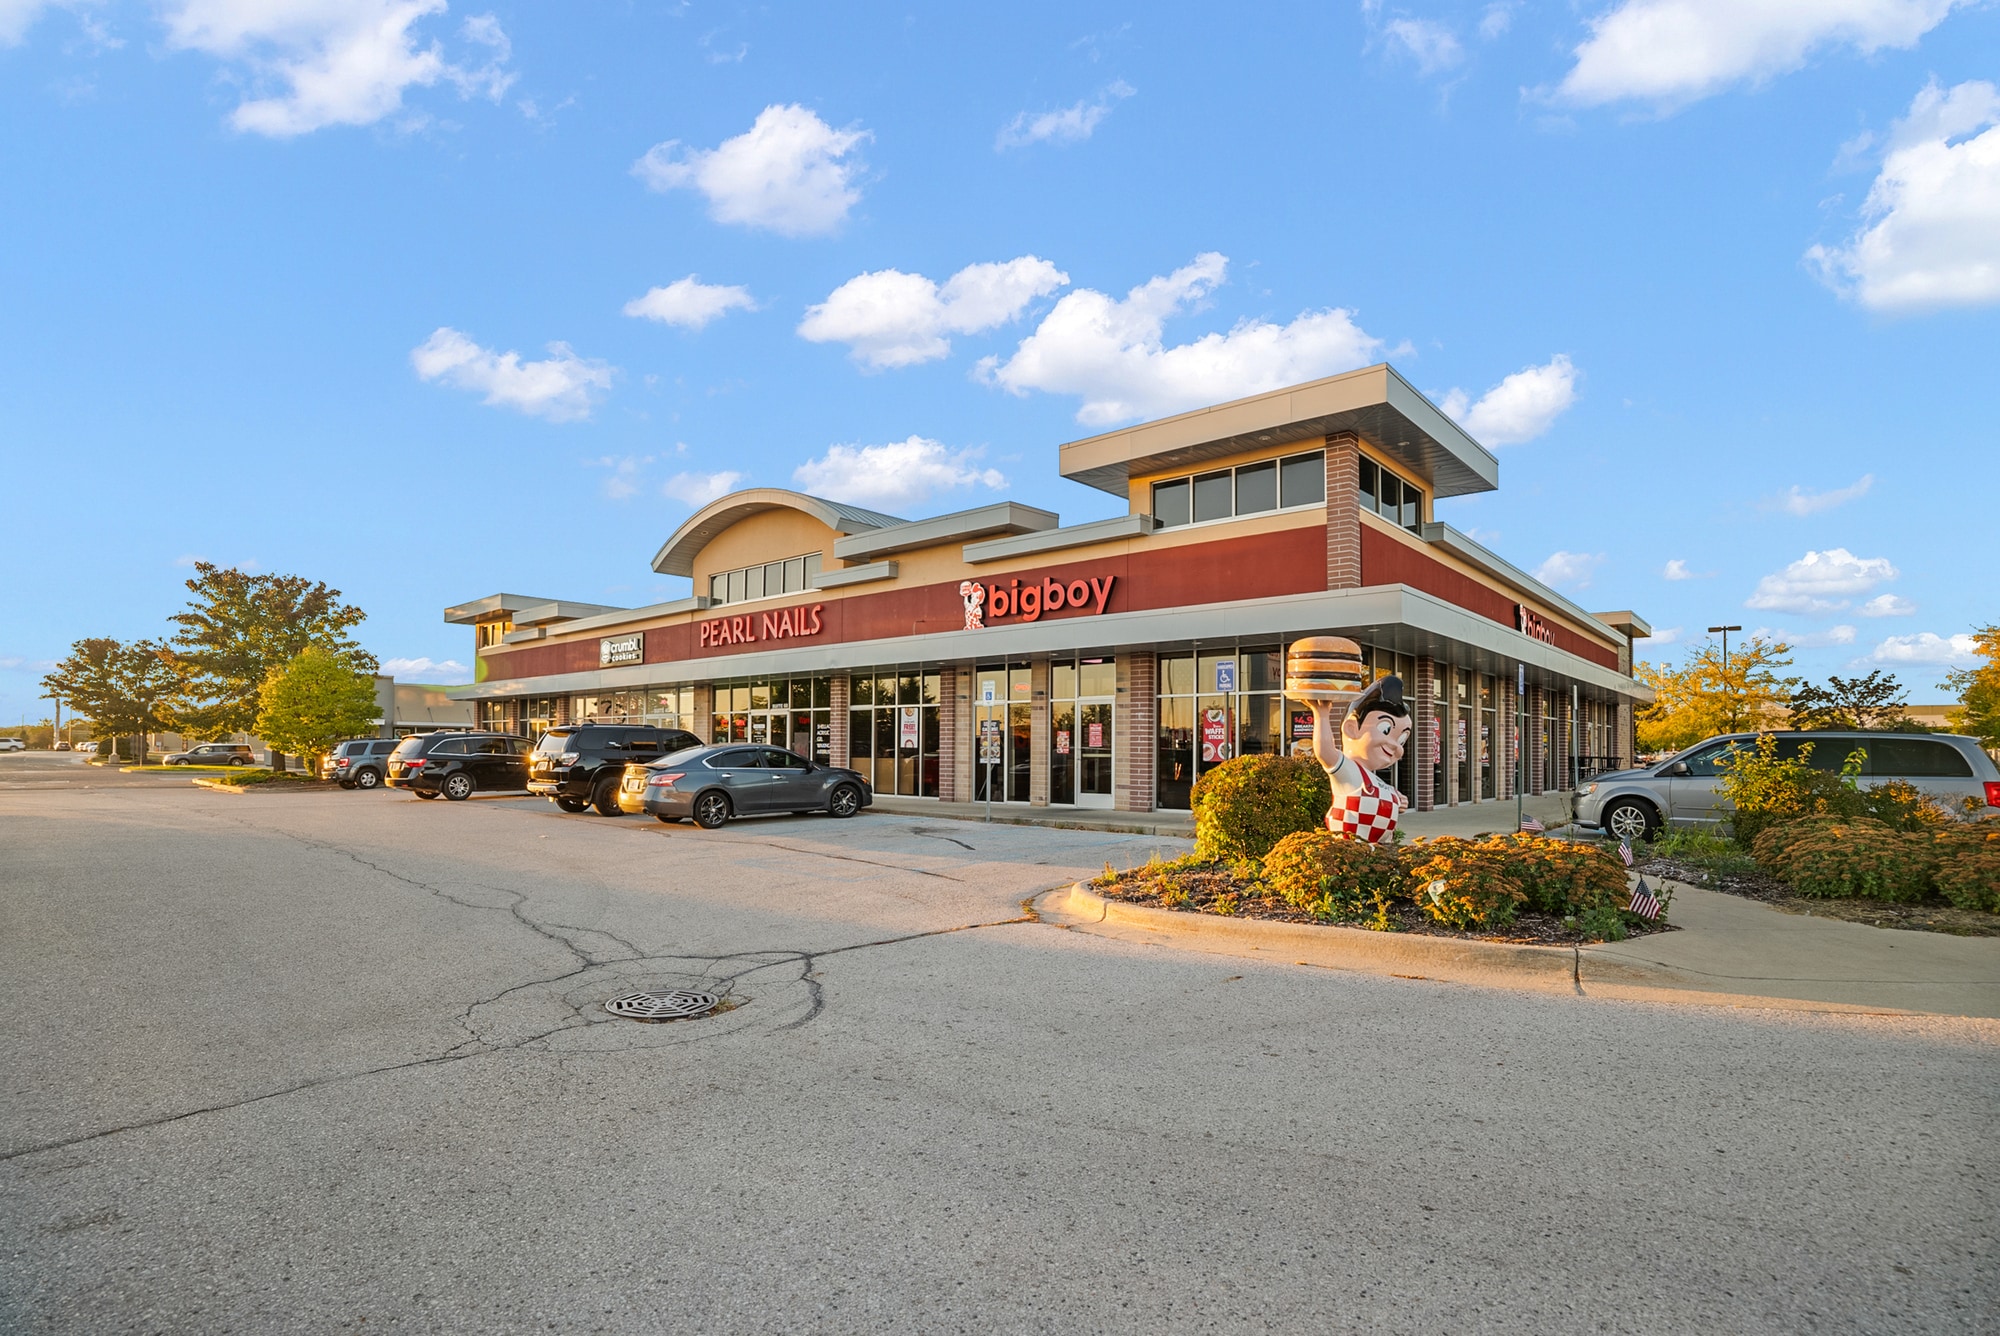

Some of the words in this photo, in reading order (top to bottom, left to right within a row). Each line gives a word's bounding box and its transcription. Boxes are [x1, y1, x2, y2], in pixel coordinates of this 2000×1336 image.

[989, 576, 1114, 622] bigboy
[700, 616, 756, 648] PEARL
[762, 605, 823, 640] NAILS
[611, 638, 639, 653] crumbl
[1294, 716, 1313, 724] $4.9
